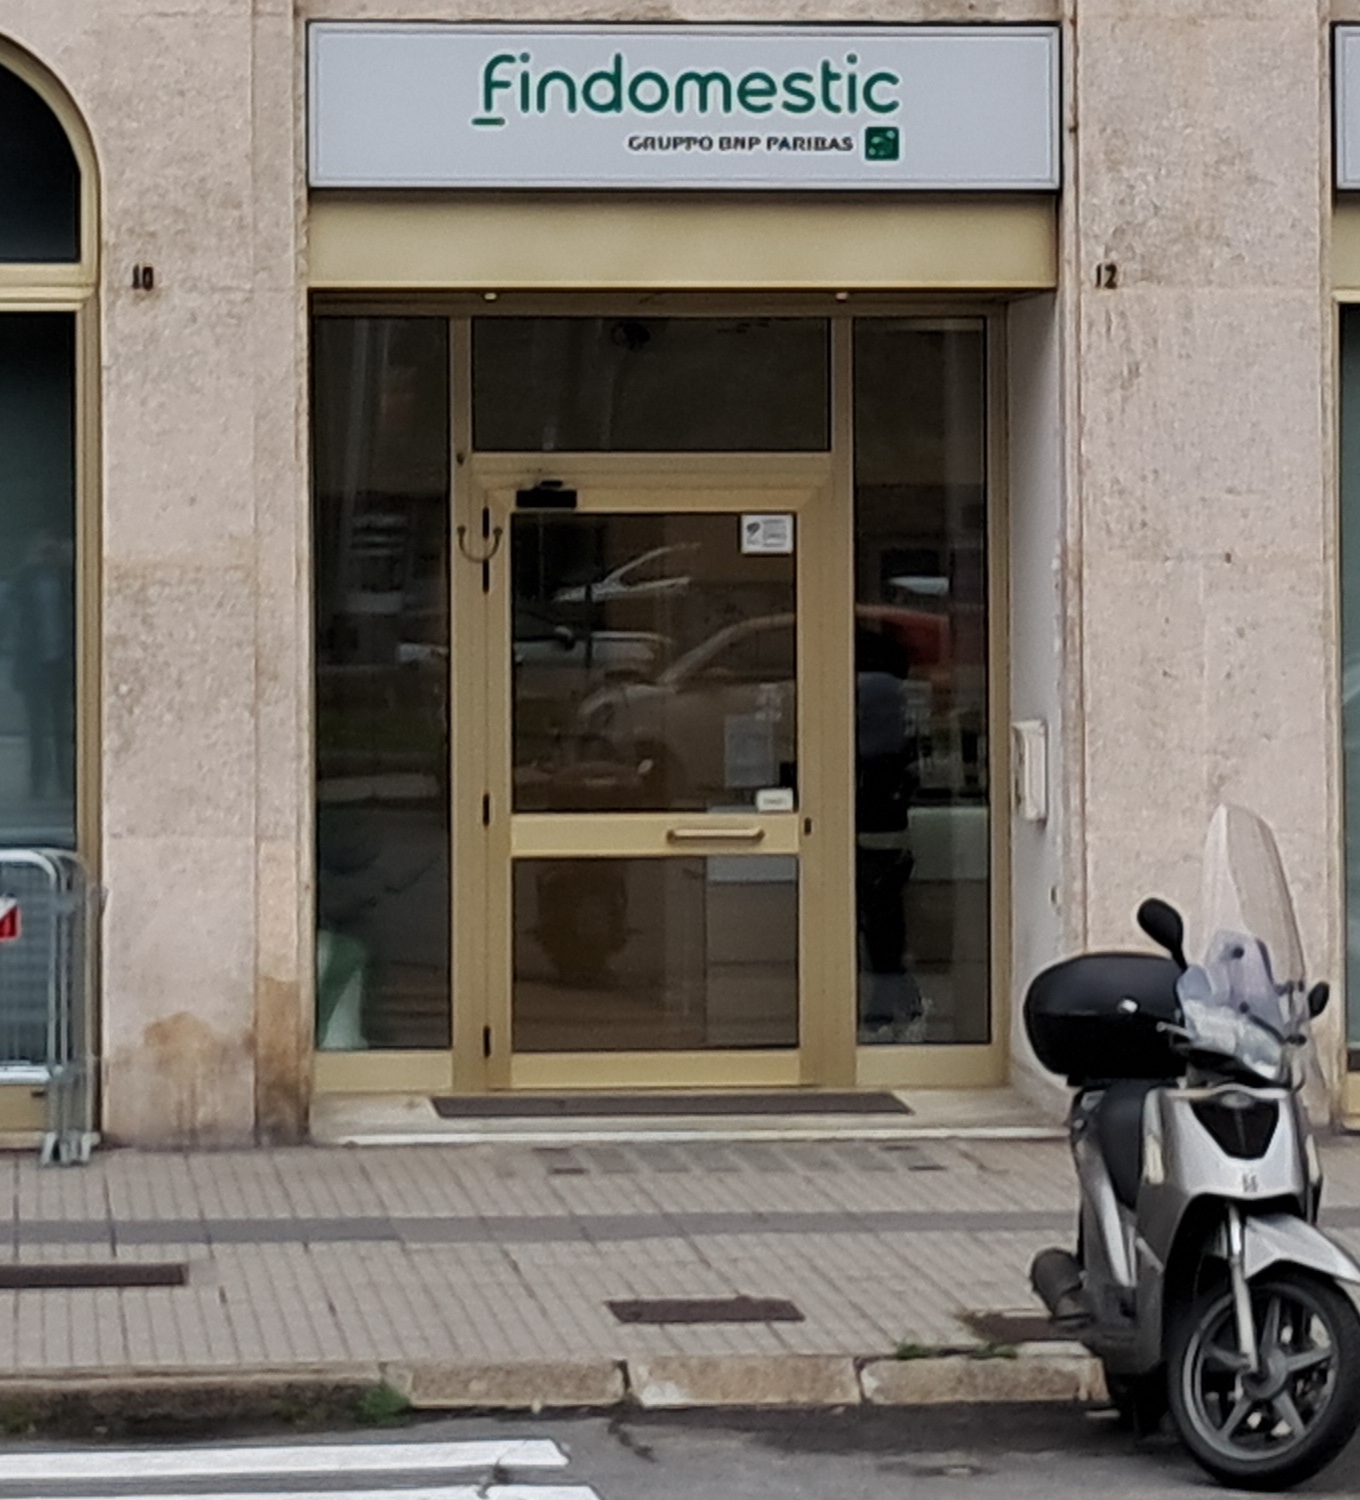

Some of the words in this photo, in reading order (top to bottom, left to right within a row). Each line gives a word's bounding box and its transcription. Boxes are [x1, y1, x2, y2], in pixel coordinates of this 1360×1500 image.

[627, 135, 714, 152] GRUPPO
[718, 135, 762, 152] BNP
[765, 135, 855, 152] PARIBAS
[132, 263, 154, 291] 10
[1095, 263, 1118, 290] 12
